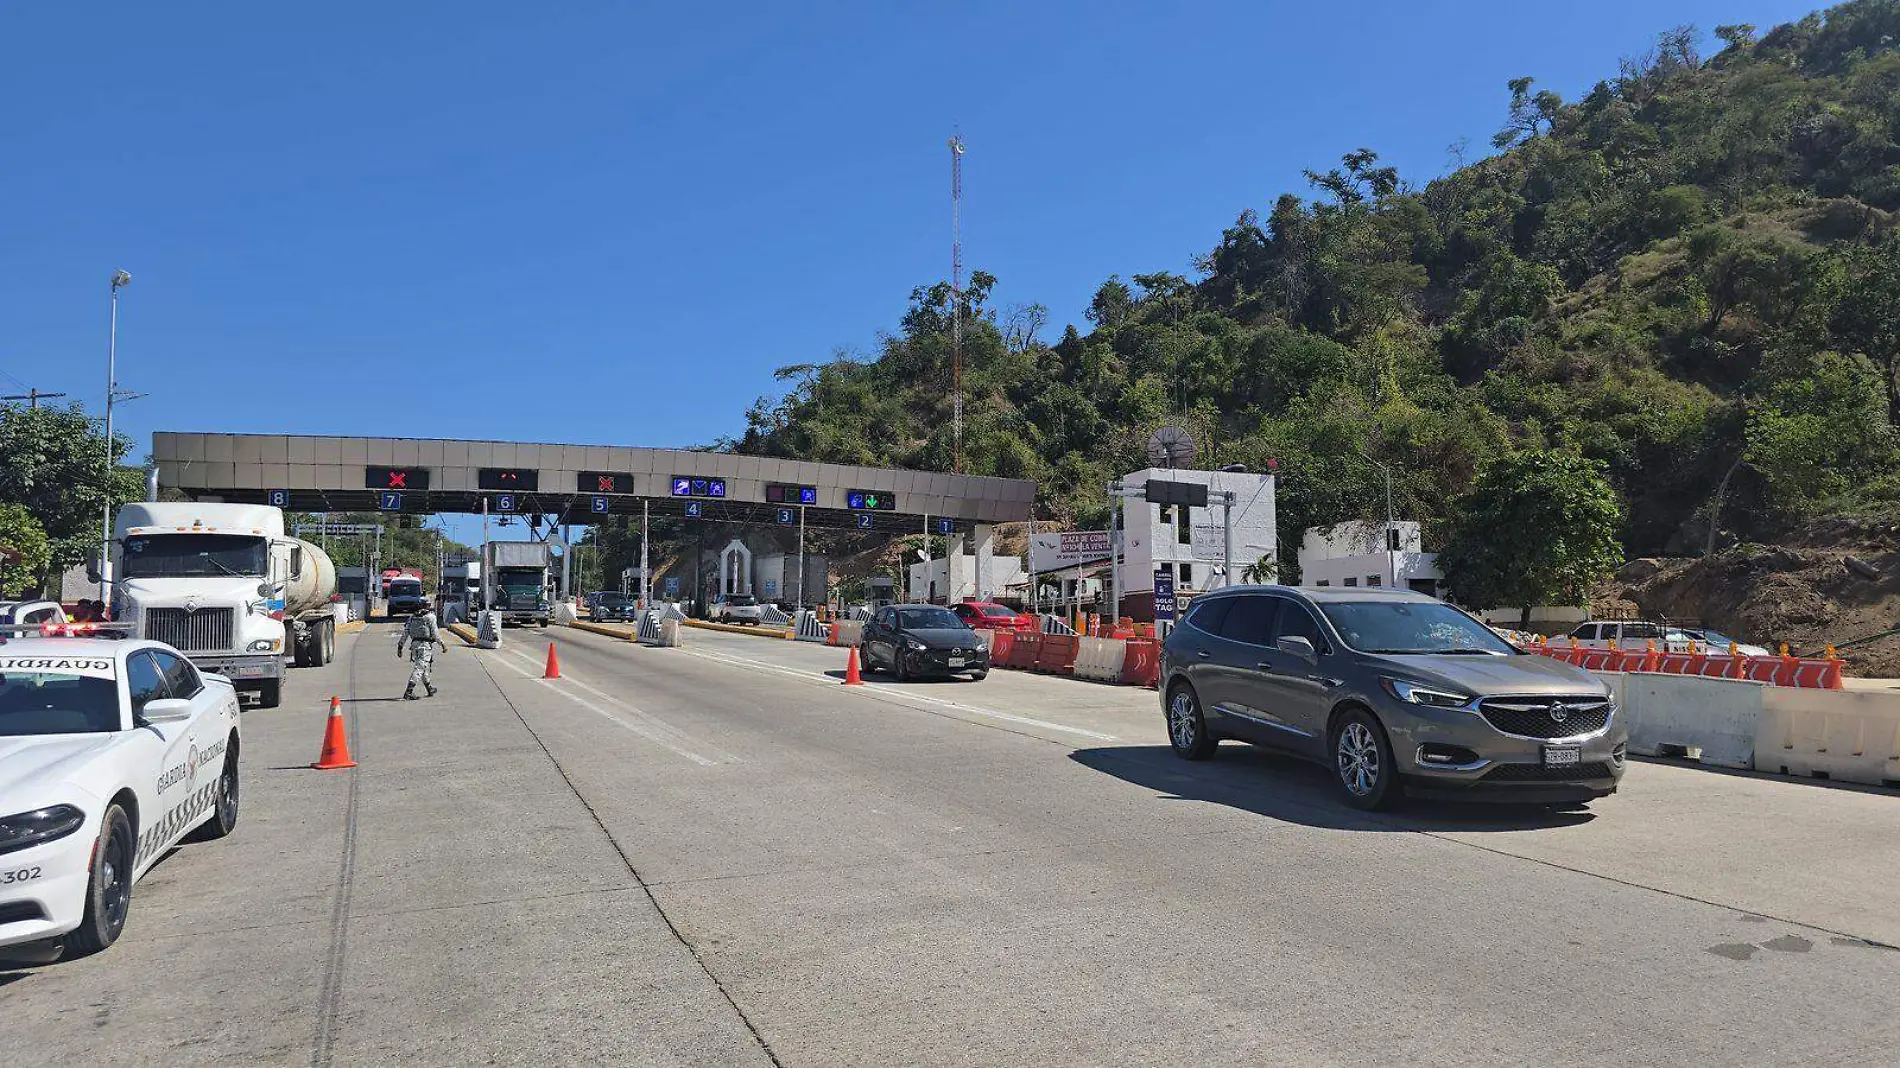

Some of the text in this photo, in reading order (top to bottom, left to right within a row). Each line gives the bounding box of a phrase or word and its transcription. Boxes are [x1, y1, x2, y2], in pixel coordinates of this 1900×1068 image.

[273, 493, 285, 505] 8
[386, 495, 396, 507] 7
[500, 497, 510, 508] 6
[596, 499, 604, 511] 5
[688, 503, 698, 515] 4
[781, 510, 790, 522] 3
[861, 516, 870, 528] 2
[943, 521, 948, 532] 1
[1155, 604, 1173, 612] TAG
